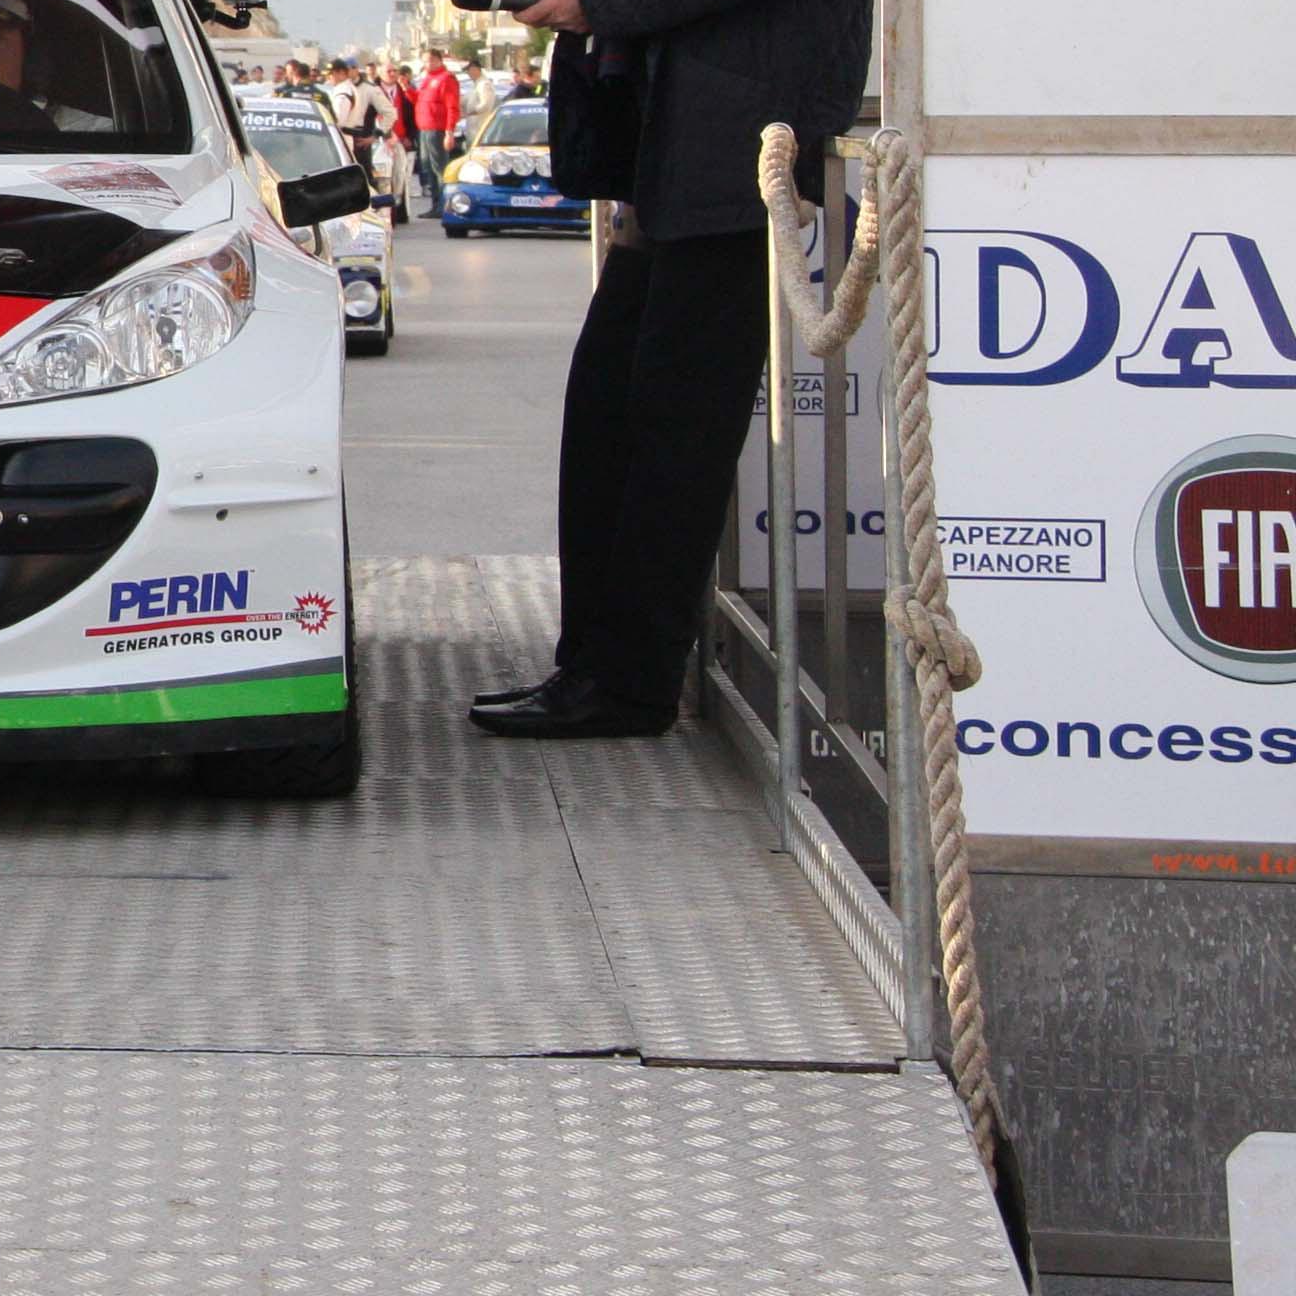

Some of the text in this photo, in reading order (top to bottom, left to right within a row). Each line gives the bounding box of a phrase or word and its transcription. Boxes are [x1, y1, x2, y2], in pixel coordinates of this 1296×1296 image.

[952, 553, 1072, 573] PIANORE
[108, 570, 250, 623] PERIN
[103, 627, 283, 654] GENERATORS GROUP
